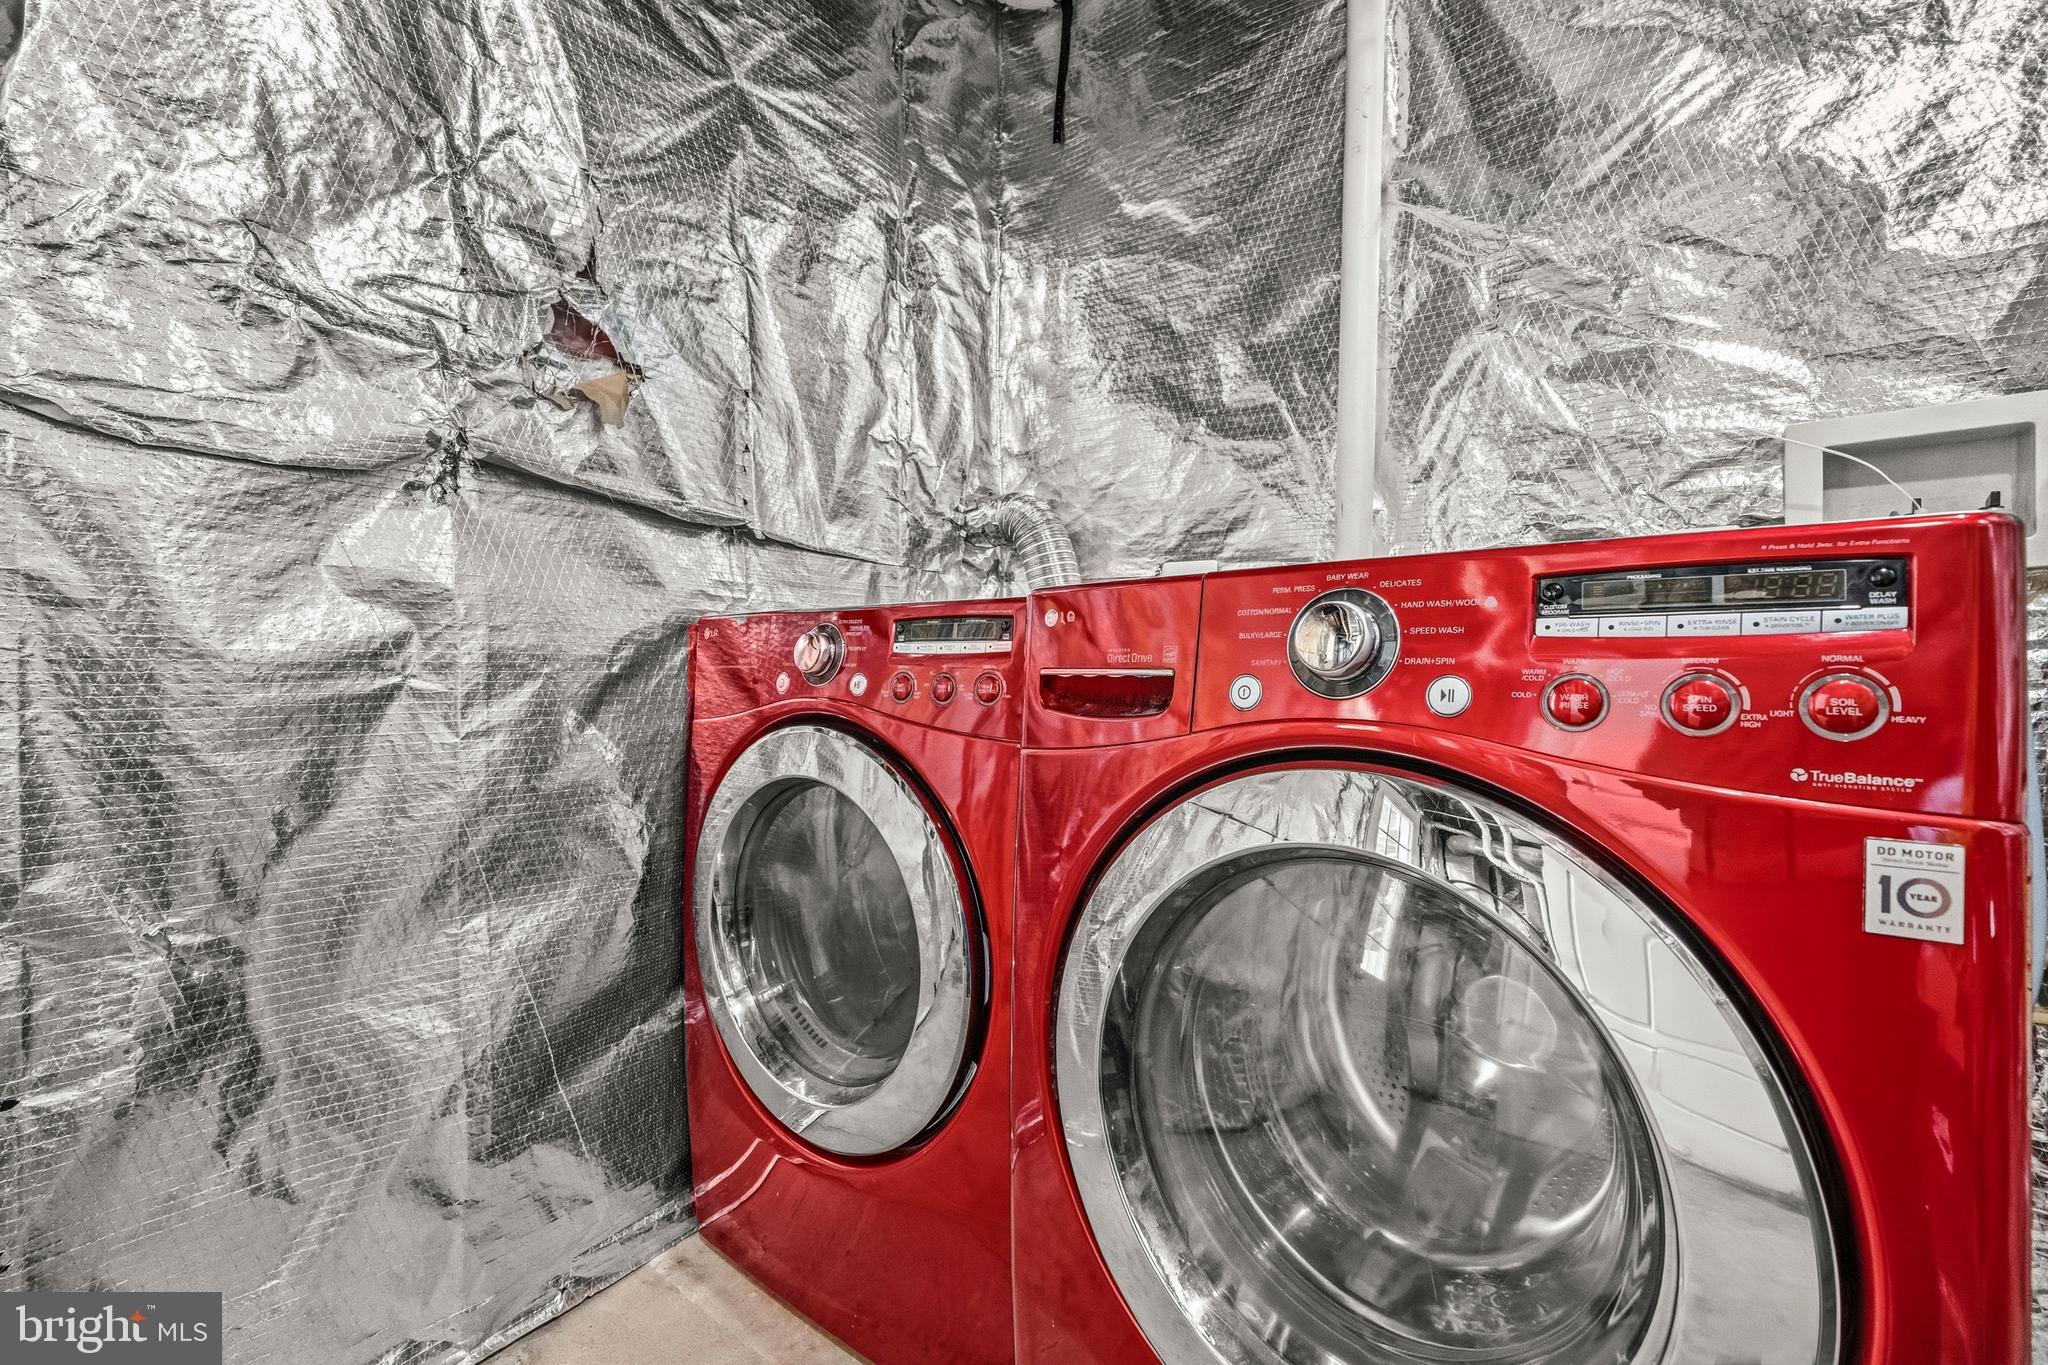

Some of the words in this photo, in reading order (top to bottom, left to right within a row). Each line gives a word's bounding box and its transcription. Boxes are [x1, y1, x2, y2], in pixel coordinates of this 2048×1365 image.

[1326, 574, 1346, 582] BABY
[1347, 572, 1369, 580] WEAR
[1379, 579, 1422, 588] DELICATES
[1237, 607, 1292, 616] COTTON/NORMAL
[1410, 627, 1436, 635] SPEED
[1438, 626, 1465, 634] WASH
[1404, 657, 1456, 665] DRAIN+SPIN
[1687, 695, 1712, 704] SPIN
[1830, 697, 1858, 707] SOIL
[1682, 703, 1717, 712] SPEED
[1825, 706, 1863, 716] LEVEL
[1740, 713, 1768, 721] EXTRA
[1891, 716, 1927, 724] HEAVY
[1877, 846, 1896, 857] DD
[1901, 848, 1955, 862] MOTOR
[1878, 874, 1952, 919] 10
[1910, 892, 1938, 903] YEAR
[1878, 918, 1952, 934] WARRANTY
